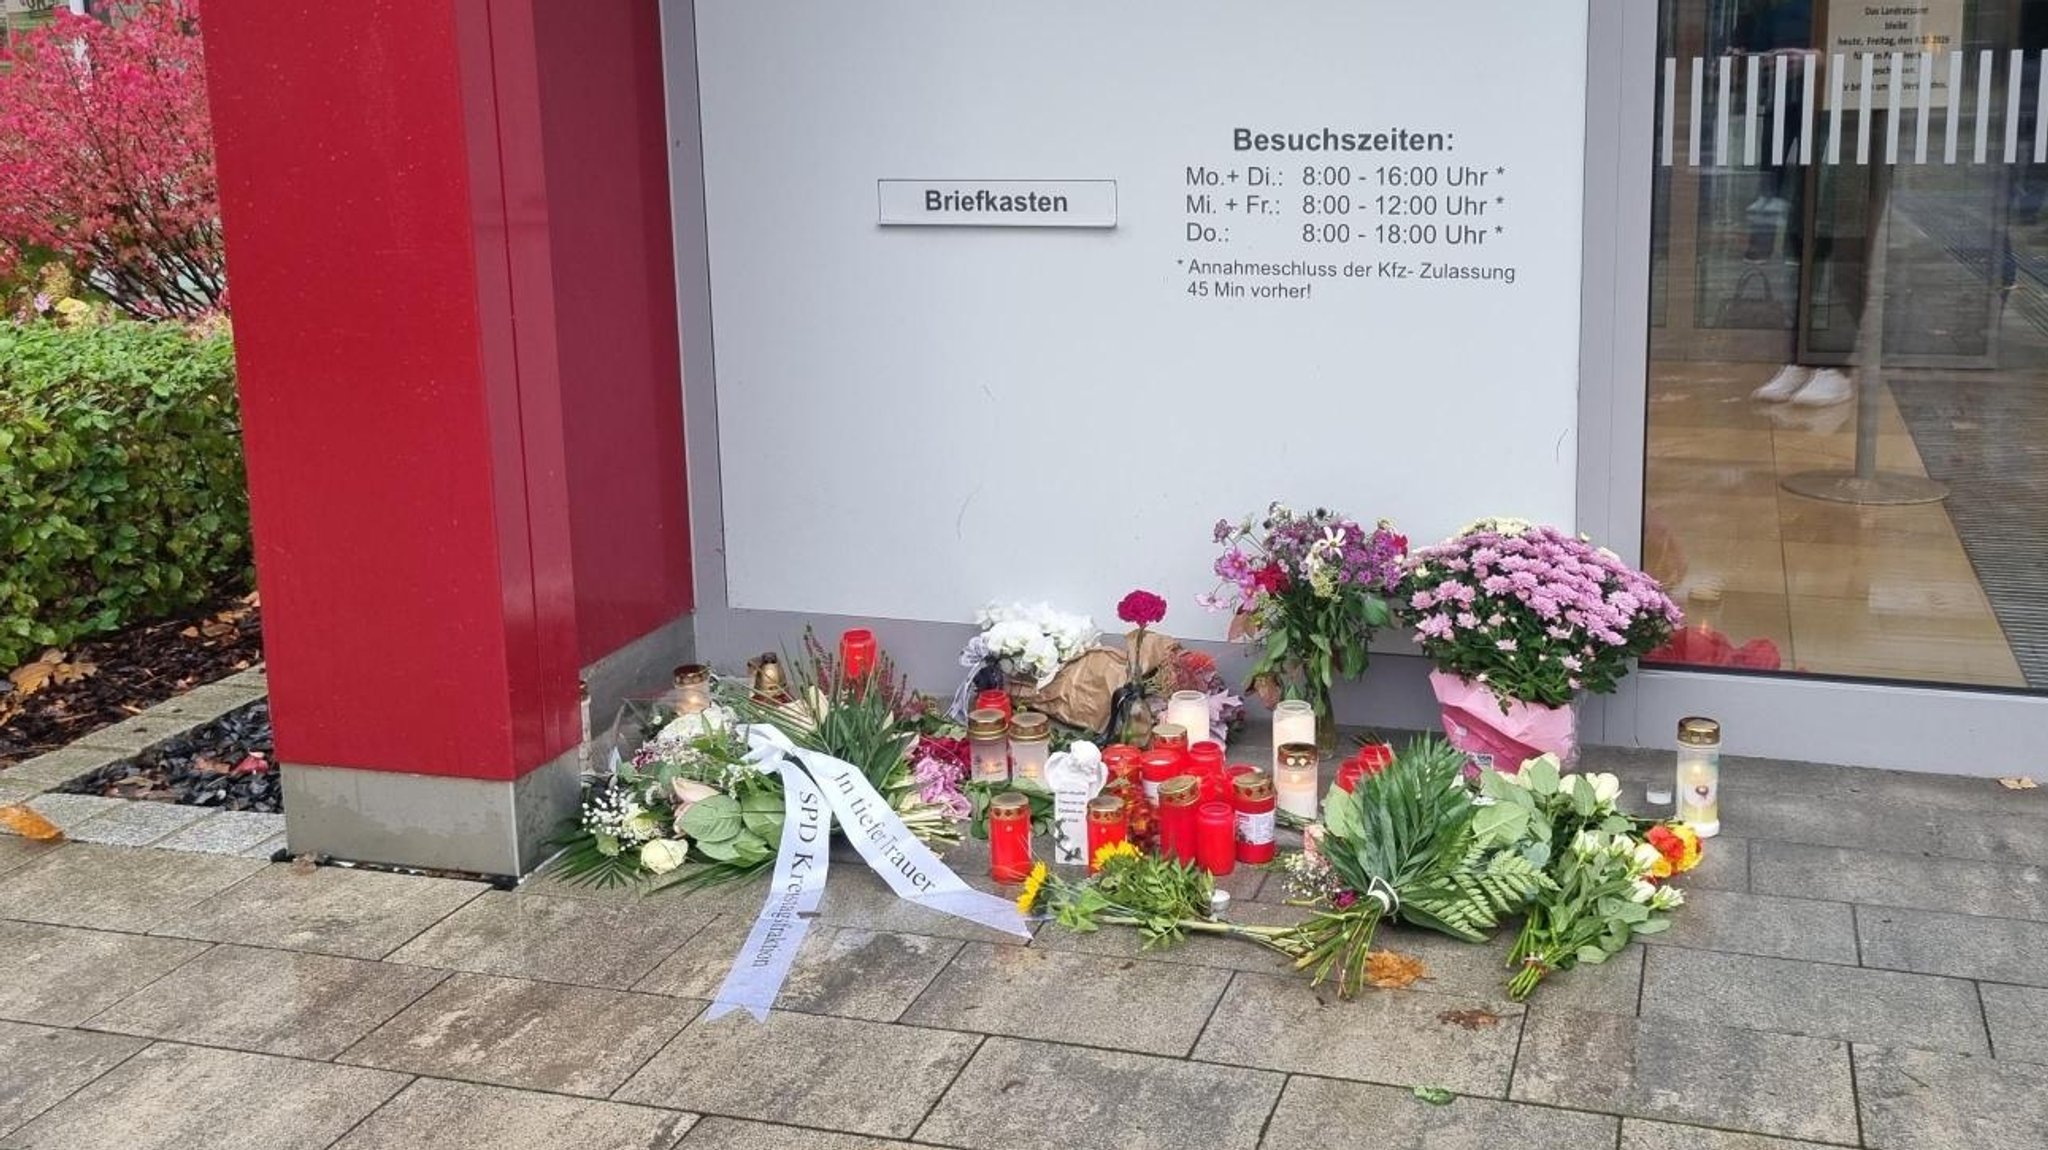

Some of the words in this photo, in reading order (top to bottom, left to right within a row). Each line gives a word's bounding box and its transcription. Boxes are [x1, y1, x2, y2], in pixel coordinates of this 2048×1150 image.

[1233, 126, 1455, 152] Besuchszeiten:
[1247, 165, 1284, 187] Di.:
[1302, 165, 1352, 187] 8:00
[1375, 165, 1439, 187] 16:00
[1446, 165, 1489, 187] Uhr
[924, 188, 1069, 213] Briefkasten
[1186, 194, 1217, 215] Mi.
[1246, 194, 1281, 216] Fr.:
[1301, 194, 1351, 216] 8:00
[1375, 194, 1438, 216] 12:00
[1446, 194, 1488, 217] Uhr
[1186, 221, 1231, 243] Do.:
[1302, 223, 1350, 244] 8:00
[1374, 223, 1437, 245] 18:00
[1445, 224, 1488, 246] Uhr
[1187, 258, 1338, 278] Annahmeschluss
[1342, 260, 1373, 278] der
[1378, 261, 1415, 279] Kfz-
[1418, 261, 1516, 285] Zulassung
[1186, 280, 1209, 297] 45
[1214, 280, 1246, 298] Min
[1249, 281, 1312, 299] vorher!
[798, 791, 818, 844] SPD
[834, 772, 854, 794] In
[850, 798, 888, 843] tiefer
[880, 835, 937, 892] Trauer
